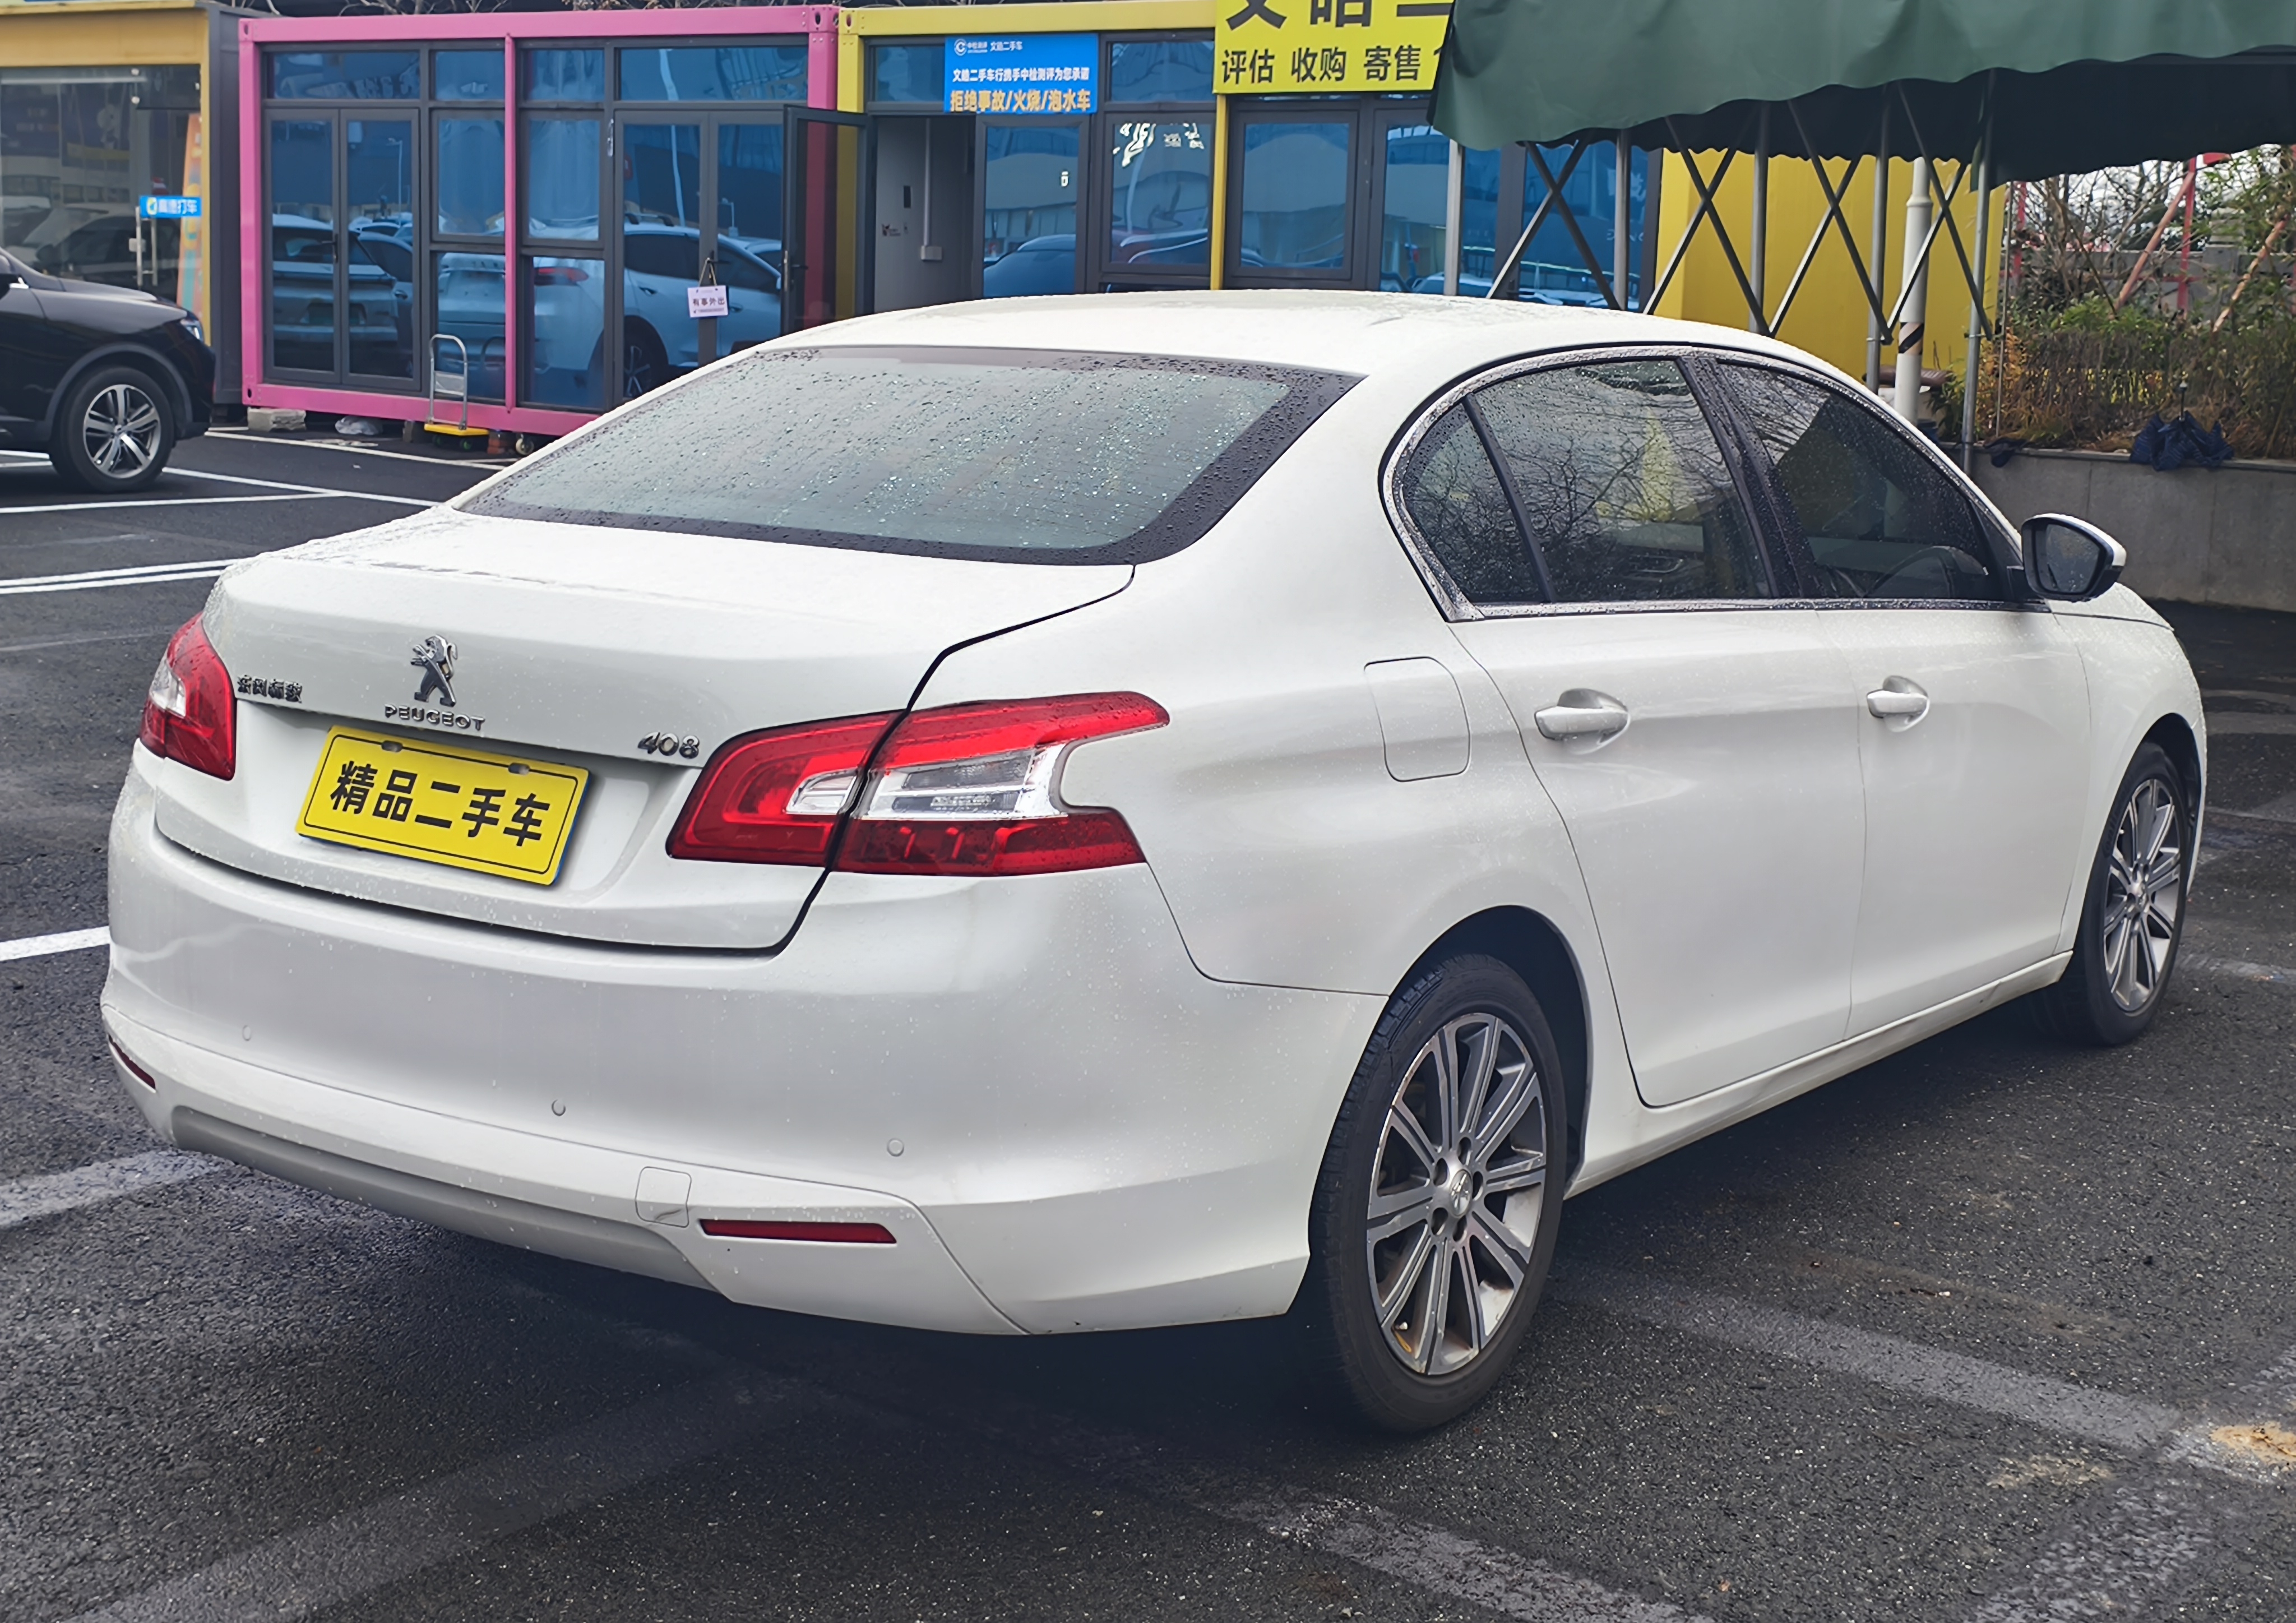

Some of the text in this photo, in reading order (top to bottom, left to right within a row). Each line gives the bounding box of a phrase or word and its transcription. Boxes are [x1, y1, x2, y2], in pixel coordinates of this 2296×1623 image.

[1222, 45, 1421, 85] 评估 收购 寄售
[950, 89, 1091, 112] 拒绝事故/火烧/泡水车
[385, 704, 485, 731] PEUGEOT
[637, 732, 700, 759] 408
[330, 760, 550, 847] 精品二手车
